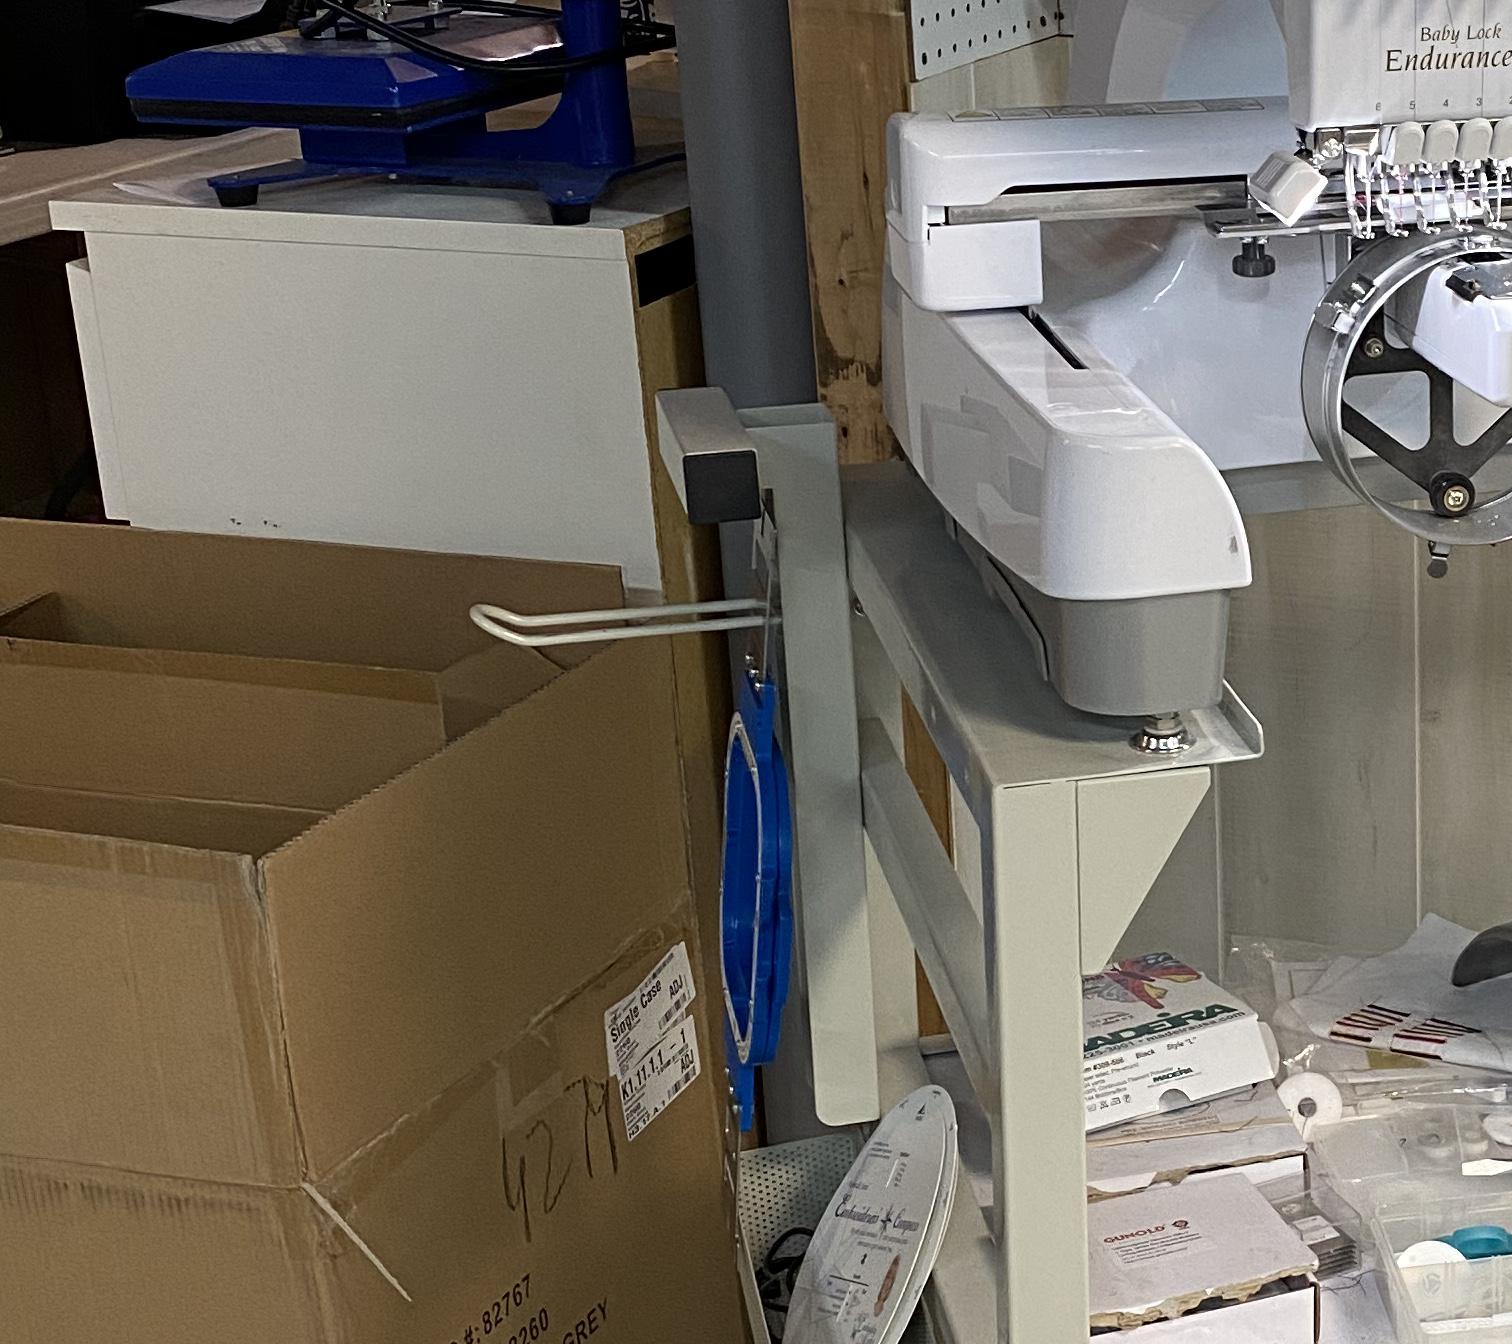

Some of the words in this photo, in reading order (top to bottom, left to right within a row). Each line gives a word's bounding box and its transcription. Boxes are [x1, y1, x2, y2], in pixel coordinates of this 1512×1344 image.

[1420, 24, 1460, 44] Baby
[1467, 22, 1502, 40] Lock
[1409, 101, 1416, 110] 5
[1442, 99, 1449, 107] 4
[1476, 97, 1483, 107] 3
[669, 974, 684, 999] ADJ
[610, 1005, 640, 1043] Single
[640, 979, 662, 1009] Case
[1084, 1004, 1238, 1051] ADEIRA
[681, 1049, 695, 1074] ADJ
[482, 1273, 531, 1336] 82767
